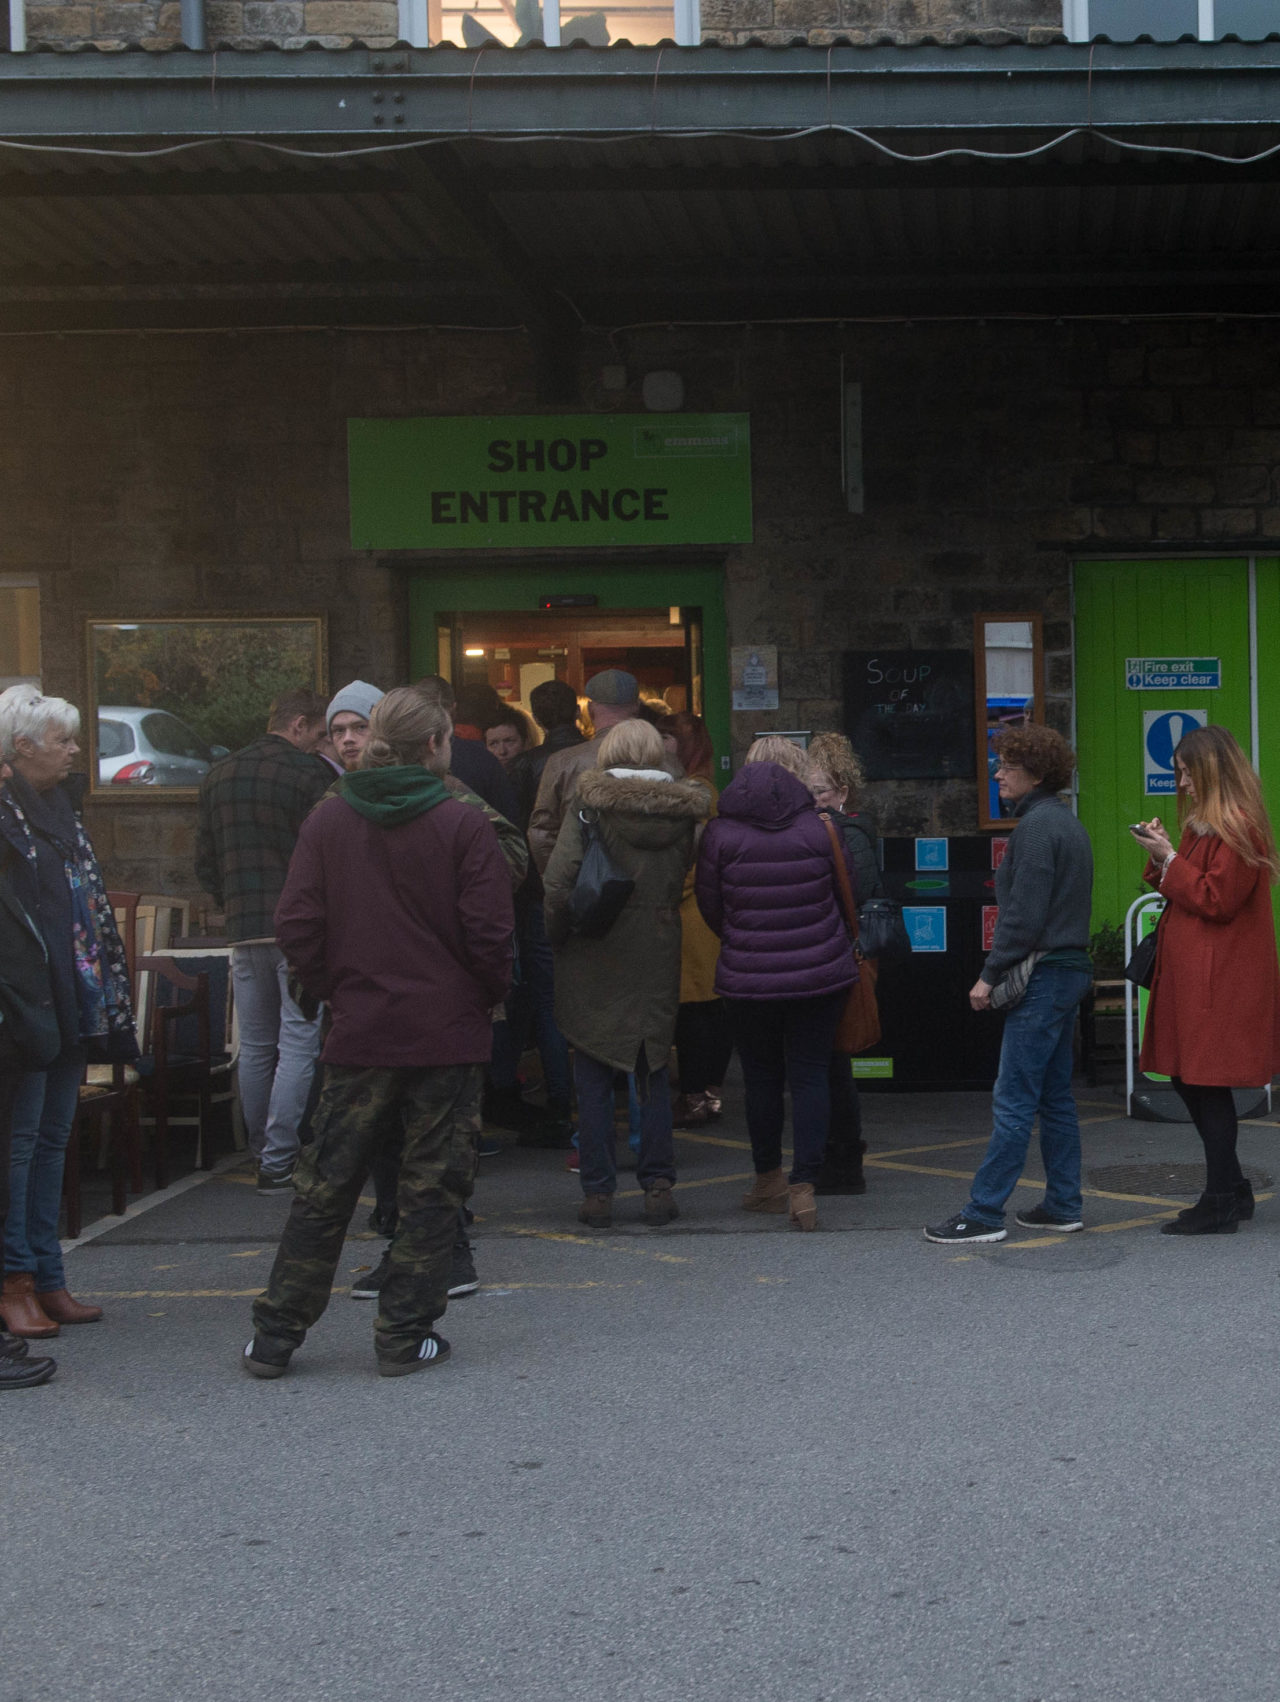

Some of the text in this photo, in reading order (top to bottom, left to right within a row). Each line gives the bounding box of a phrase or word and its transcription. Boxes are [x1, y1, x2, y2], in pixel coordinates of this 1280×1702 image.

[487, 438, 608, 473] SHOP
[431, 487, 669, 524] ENTRANCE
[1144, 661, 1194, 673] Fire exit
[1144, 674, 1212, 687] Keep clear
[906, 704, 927, 713] DAY
[1149, 778, 1177, 789] Keep
